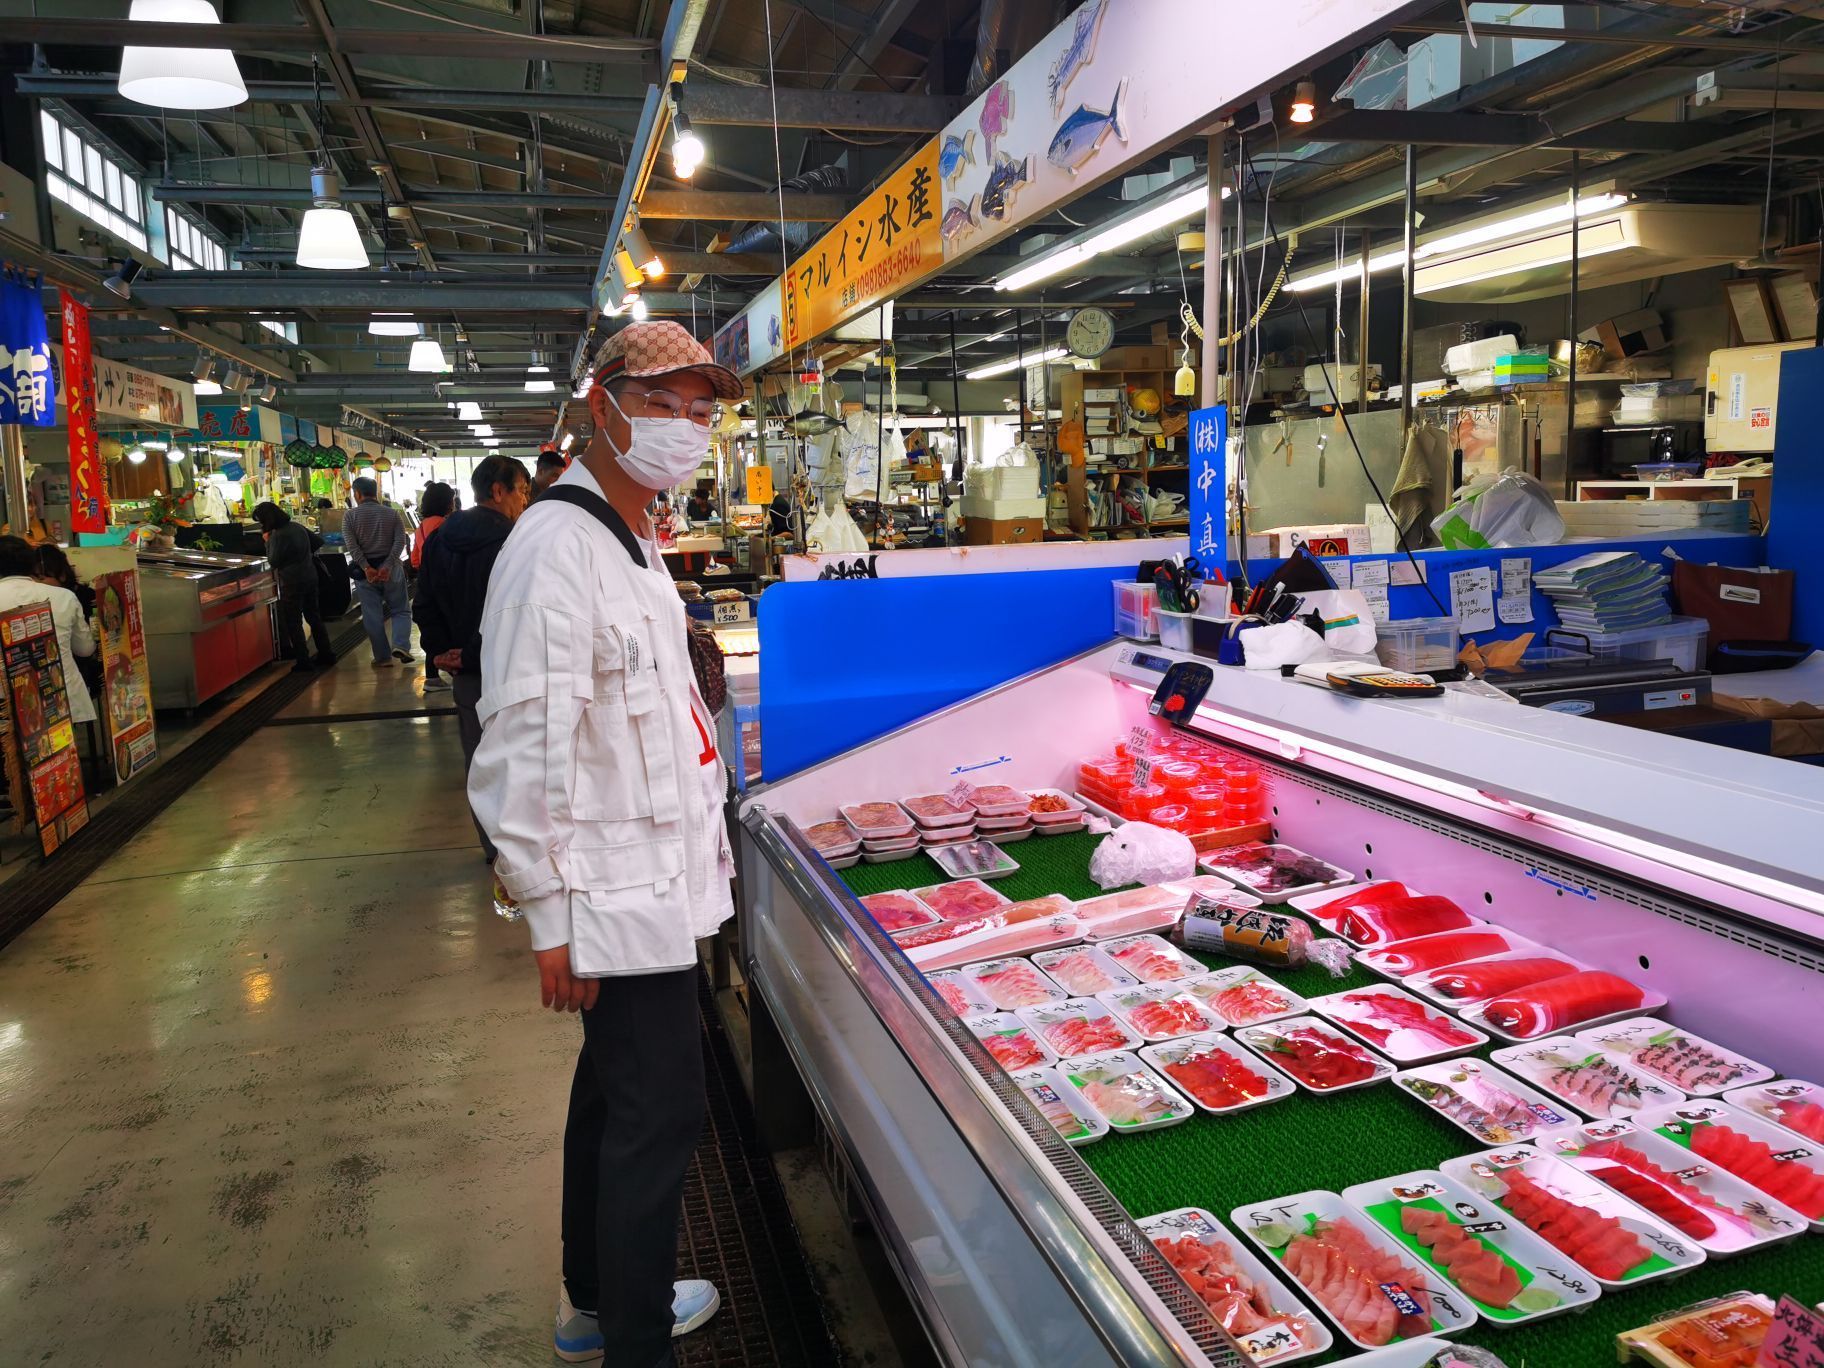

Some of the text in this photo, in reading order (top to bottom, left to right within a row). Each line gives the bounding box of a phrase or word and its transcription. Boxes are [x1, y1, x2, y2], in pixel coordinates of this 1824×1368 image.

[800, 166, 933, 300] マルイシ水産
[1774, 1149, 1809, 1161] 中トロ
[1676, 1165, 1709, 1180] 中トロ
[1463, 1221, 1504, 1234] 中トロ
